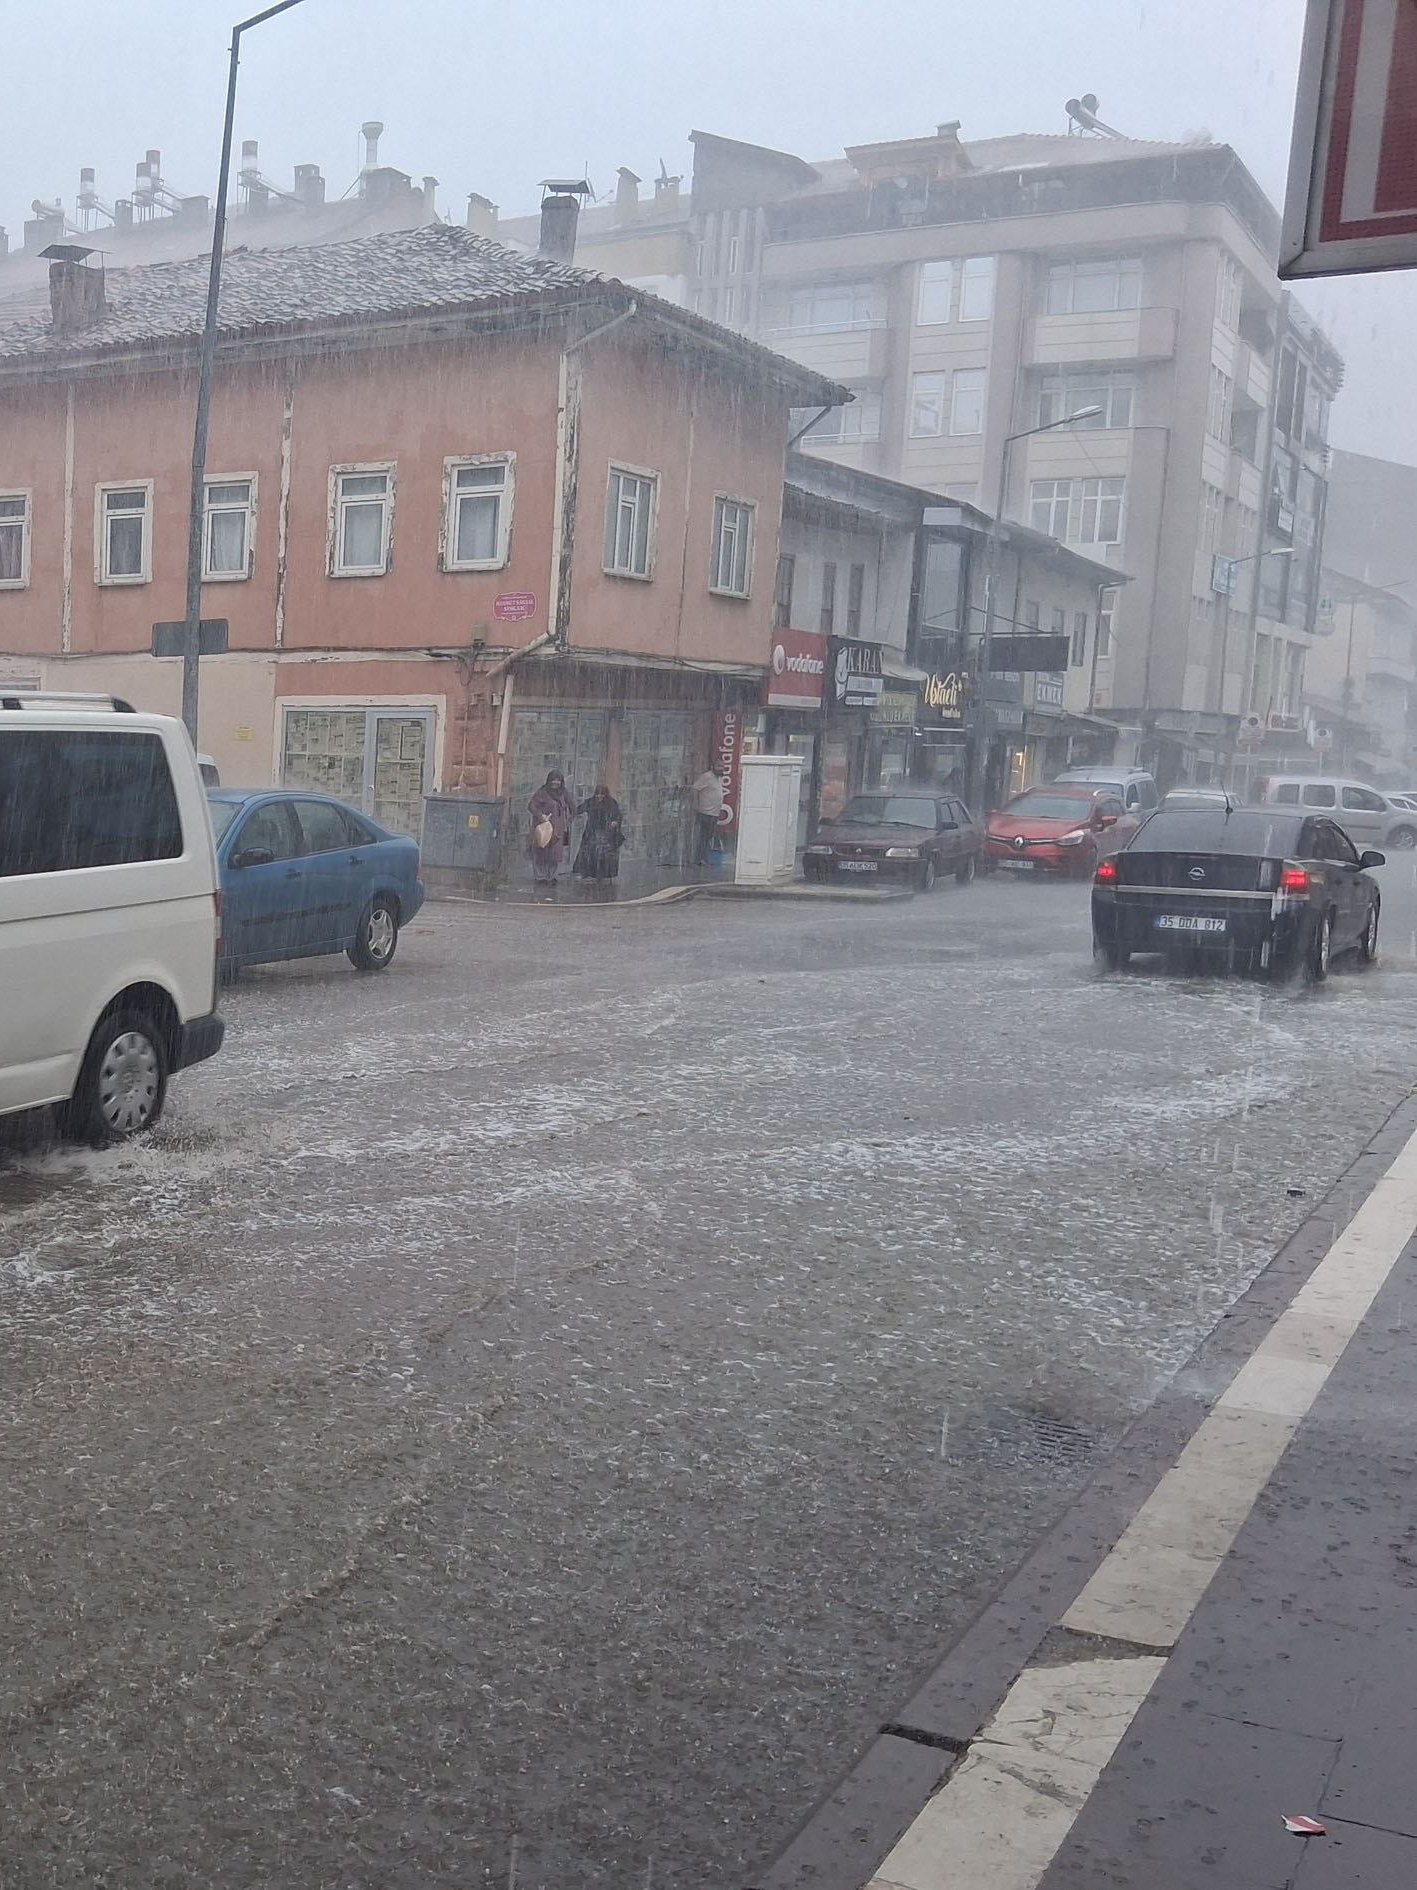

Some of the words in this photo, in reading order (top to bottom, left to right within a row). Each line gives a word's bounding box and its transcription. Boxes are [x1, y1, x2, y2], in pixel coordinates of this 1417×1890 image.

[786, 652, 824, 675] vodafone
[1161, 916, 1174, 927] 35
[1204, 919, 1223, 932] 812
